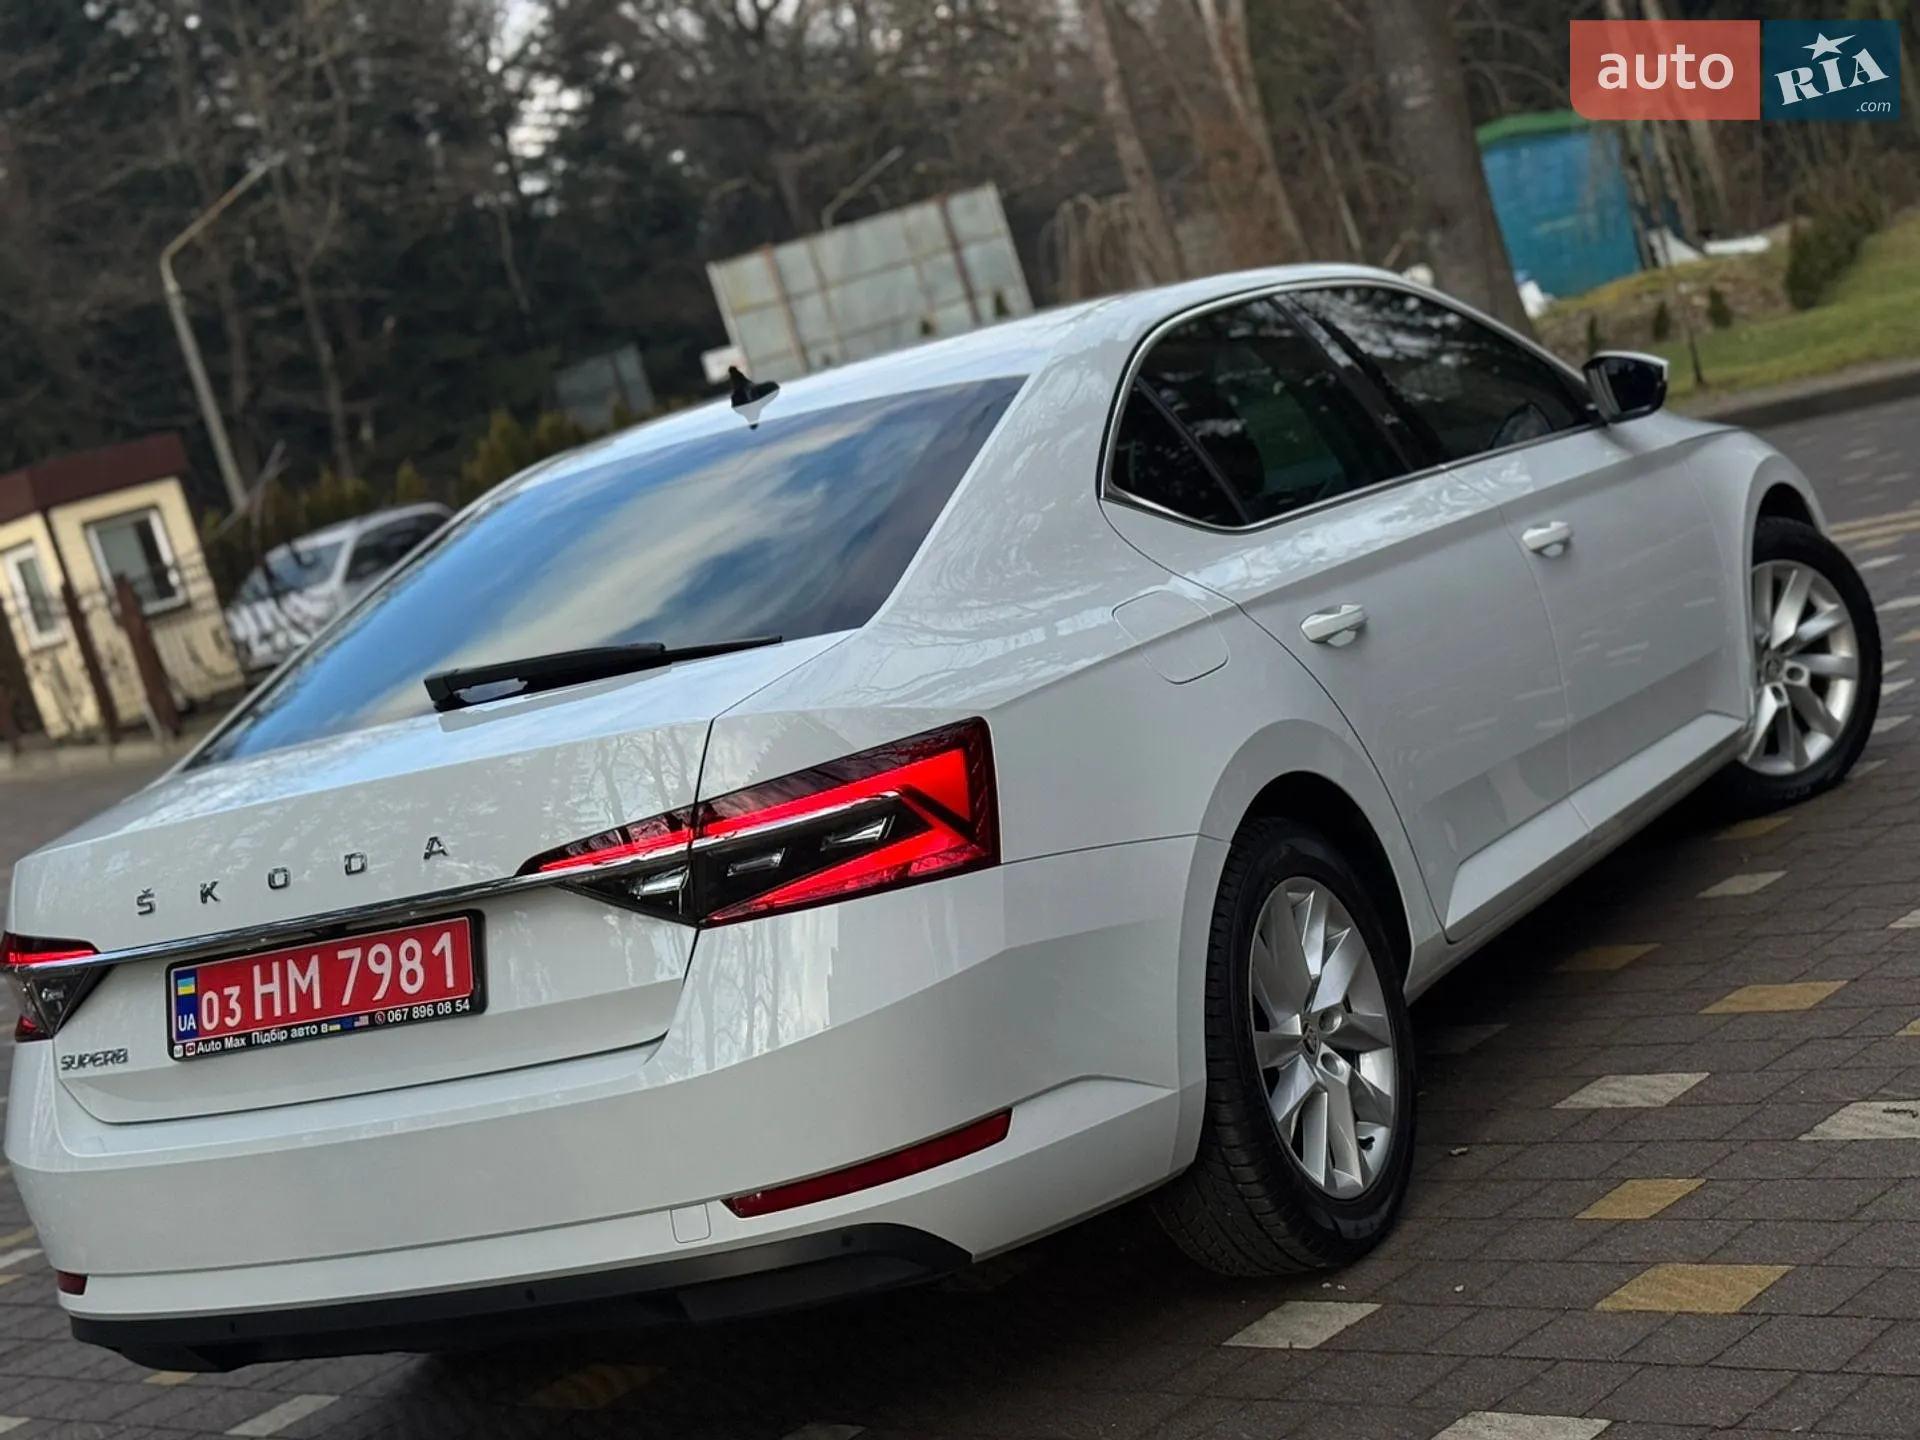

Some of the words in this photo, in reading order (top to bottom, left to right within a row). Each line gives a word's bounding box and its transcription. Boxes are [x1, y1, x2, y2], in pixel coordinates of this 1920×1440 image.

[201, 985, 242, 1031] 03
[252, 955, 322, 1020] HM
[337, 931, 455, 1006] 7981
[387, 1008, 410, 1023] 067
[411, 1003, 435, 1019] 896
[437, 1001, 453, 1014] 08
[455, 998, 471, 1013] 54
[178, 1014, 197, 1032] UA
[197, 1041, 222, 1054] Auto
[224, 1036, 247, 1050] Max
[61, 1049, 129, 1071] SUPERB
